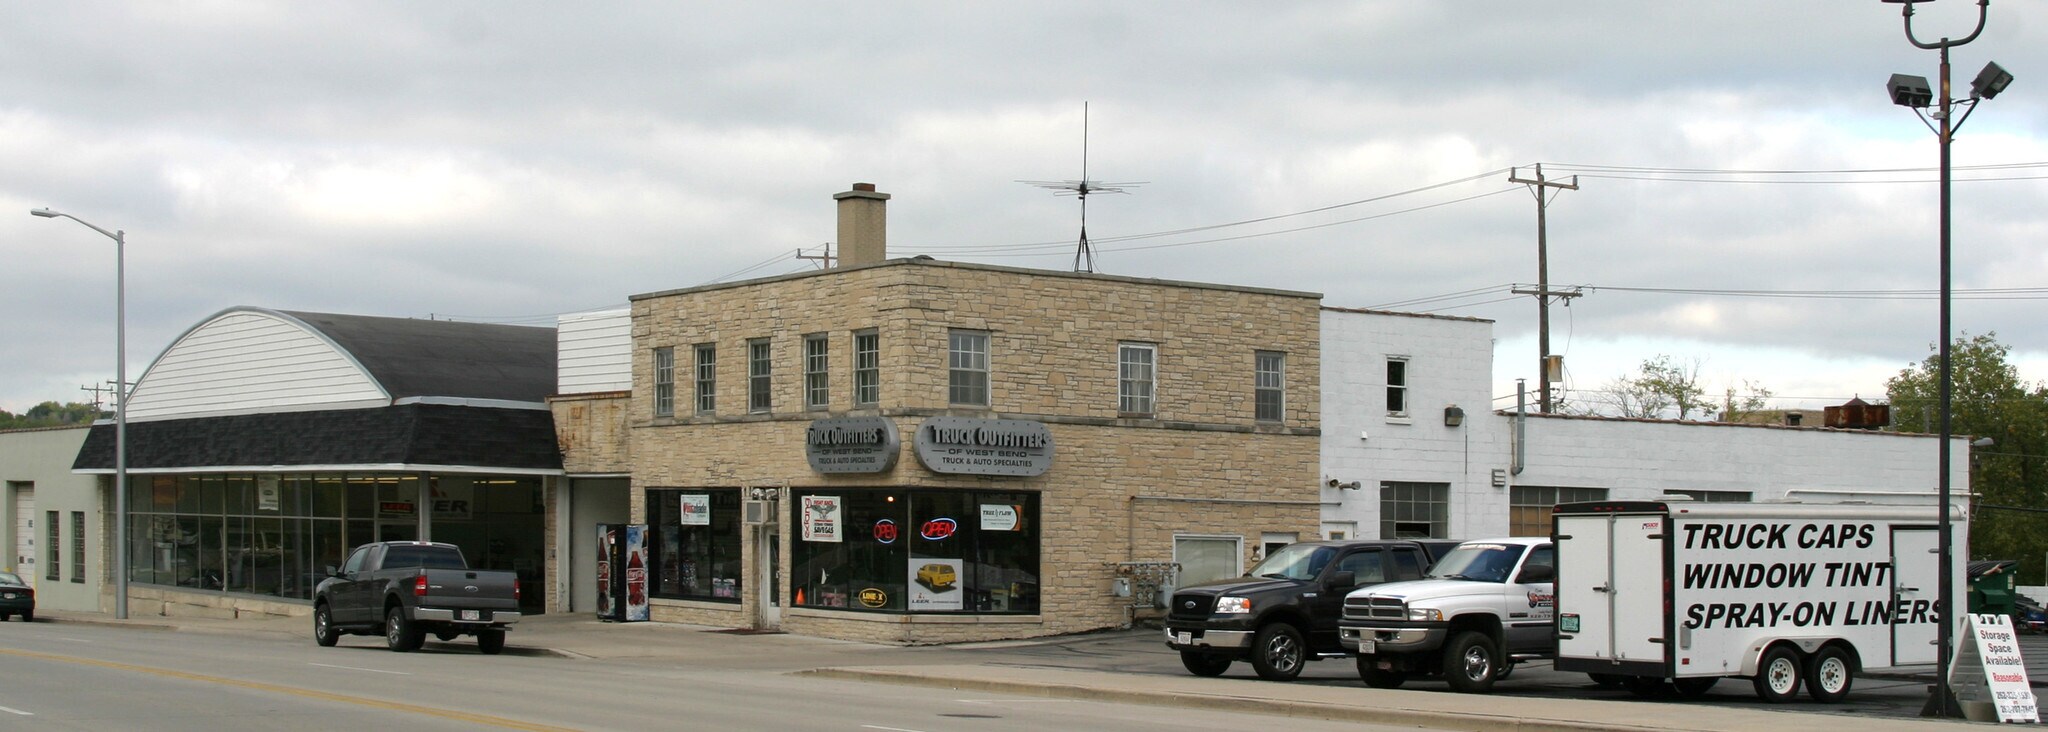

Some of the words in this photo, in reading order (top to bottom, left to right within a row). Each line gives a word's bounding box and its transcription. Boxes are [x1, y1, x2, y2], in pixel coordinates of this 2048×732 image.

[831, 427, 879, 445] OUTFITTERS
[933, 427, 976, 445] TRUCK
[977, 428, 1047, 448] OUTFITTERS
[942, 457, 964, 465] TRUCK
[973, 458, 992, 466] AUTO
[993, 459, 1032, 467] SPECIALTIES
[874, 523, 897, 539] OPEN
[922, 521, 955, 537] OPEN
[1683, 523, 1791, 550] TRUCK
[1797, 523, 1875, 549] CAPS
[1683, 562, 1816, 589] WINDOW
[1824, 562, 1891, 587] TINT
[1684, 601, 1837, 629] SPRAY-ON
[1843, 599, 1940, 625] LINERS
[1980, 630, 2010, 642] Storage
[1988, 643, 2012, 654] Space
[1986, 656, 2022, 666] Available!
[1993, 672, 2023, 682] Reasonable
